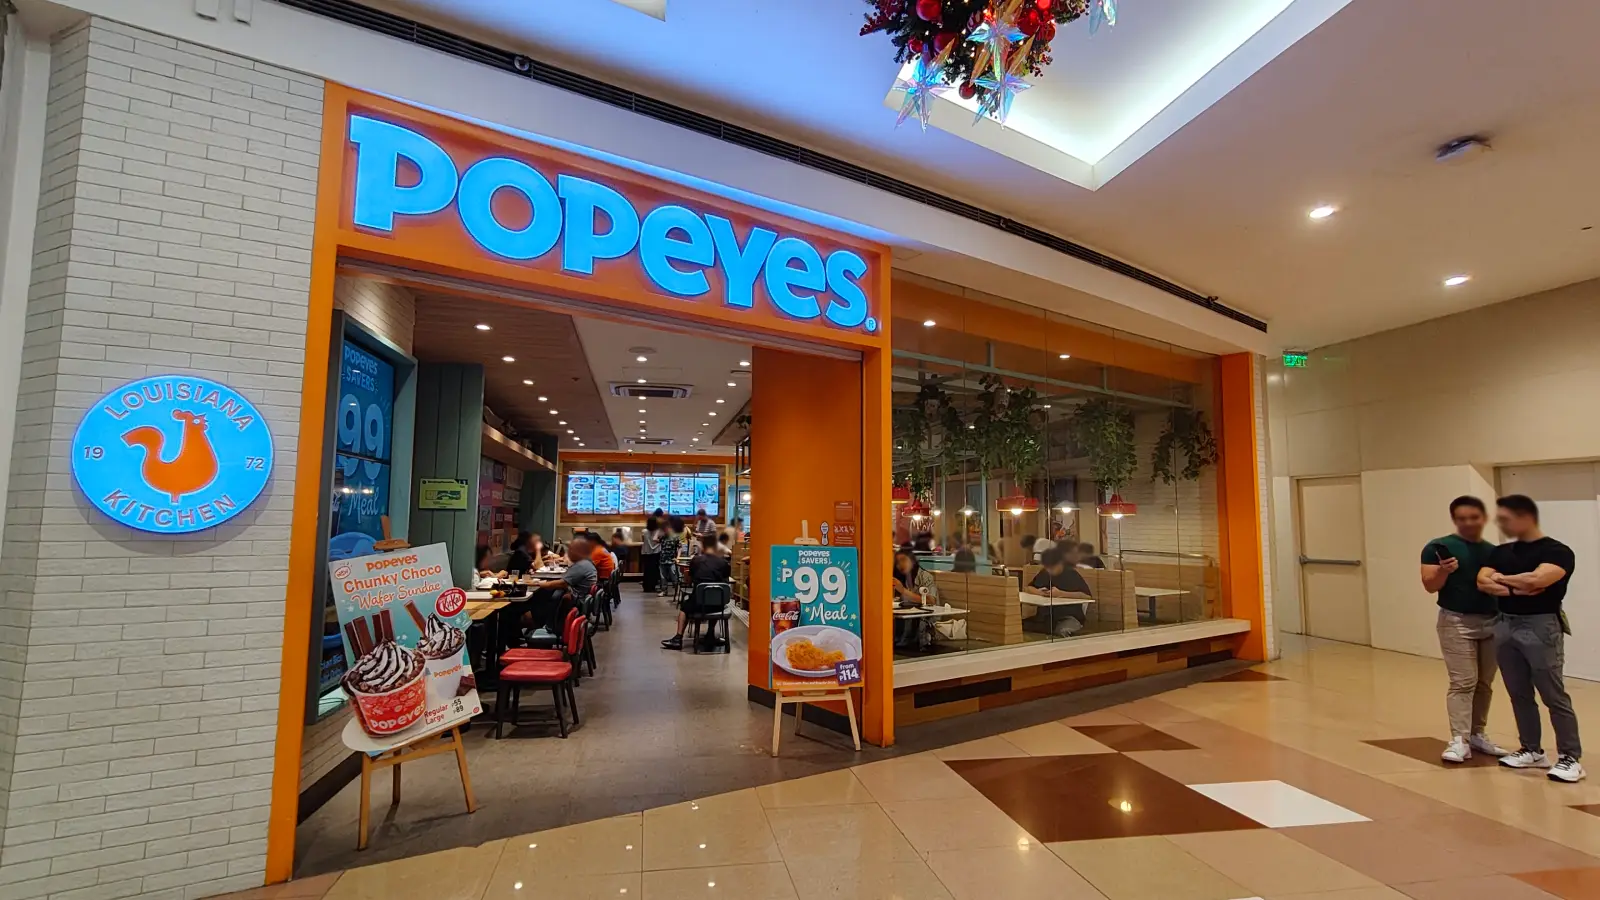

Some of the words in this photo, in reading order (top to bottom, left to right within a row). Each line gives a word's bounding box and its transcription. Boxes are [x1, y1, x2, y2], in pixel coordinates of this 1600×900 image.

[1283, 354, 1307, 367] EXIT
[104, 383, 254, 431] LOUISIANA
[84, 447, 104, 459] 19
[245, 457, 264, 469] 72
[103, 488, 237, 526] KITCHEN
[348, 482, 379, 523] Meal
[344, 573, 398, 593] Chunky
[401, 565, 441, 580] Choco
[351, 590, 395, 610] Wafer
[398, 581, 441, 600] Sundae
[809, 603, 848, 624] Meal
[424, 704, 449, 717] Regular
[425, 713, 445, 725] Large
